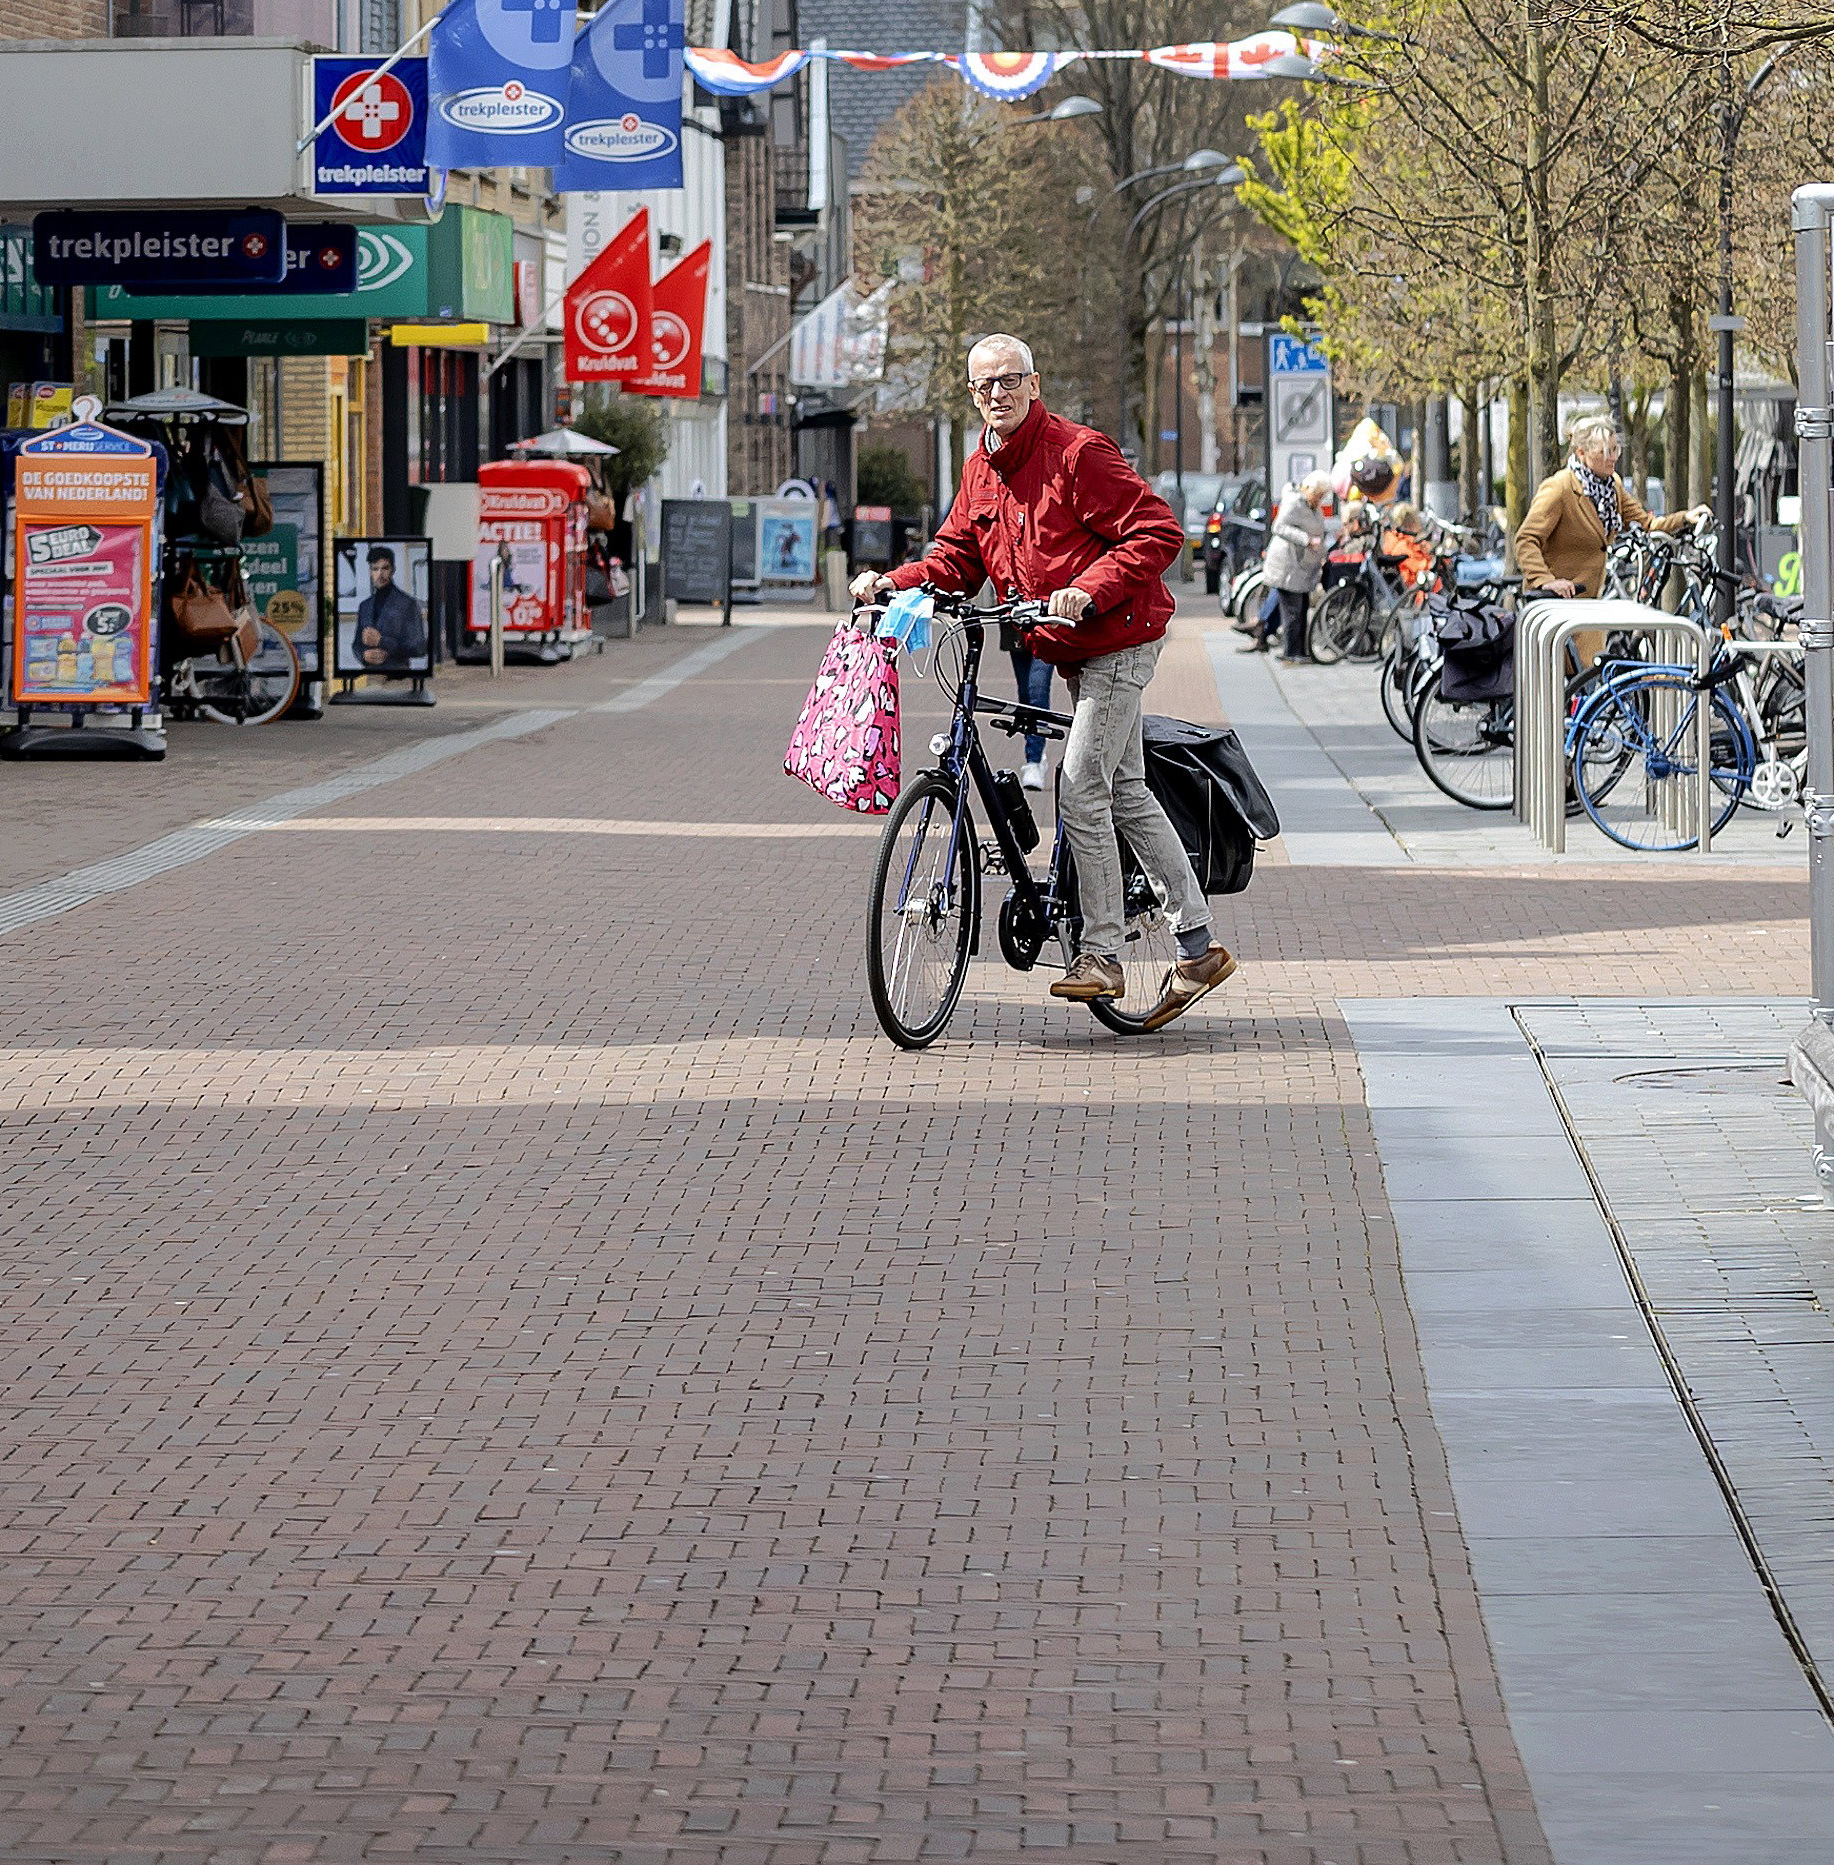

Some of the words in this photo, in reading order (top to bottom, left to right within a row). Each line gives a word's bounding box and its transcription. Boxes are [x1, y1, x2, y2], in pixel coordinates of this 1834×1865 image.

[458, 101, 546, 117] trekpleister
[578, 132, 659, 147] trekpleister
[317, 165, 427, 186] trekpleister
[48, 231, 235, 264] trekpleister
[44, 472, 150, 486] GOEDKOOPSTE
[24, 487, 54, 500] VAN
[30, 535, 51, 562] 5
